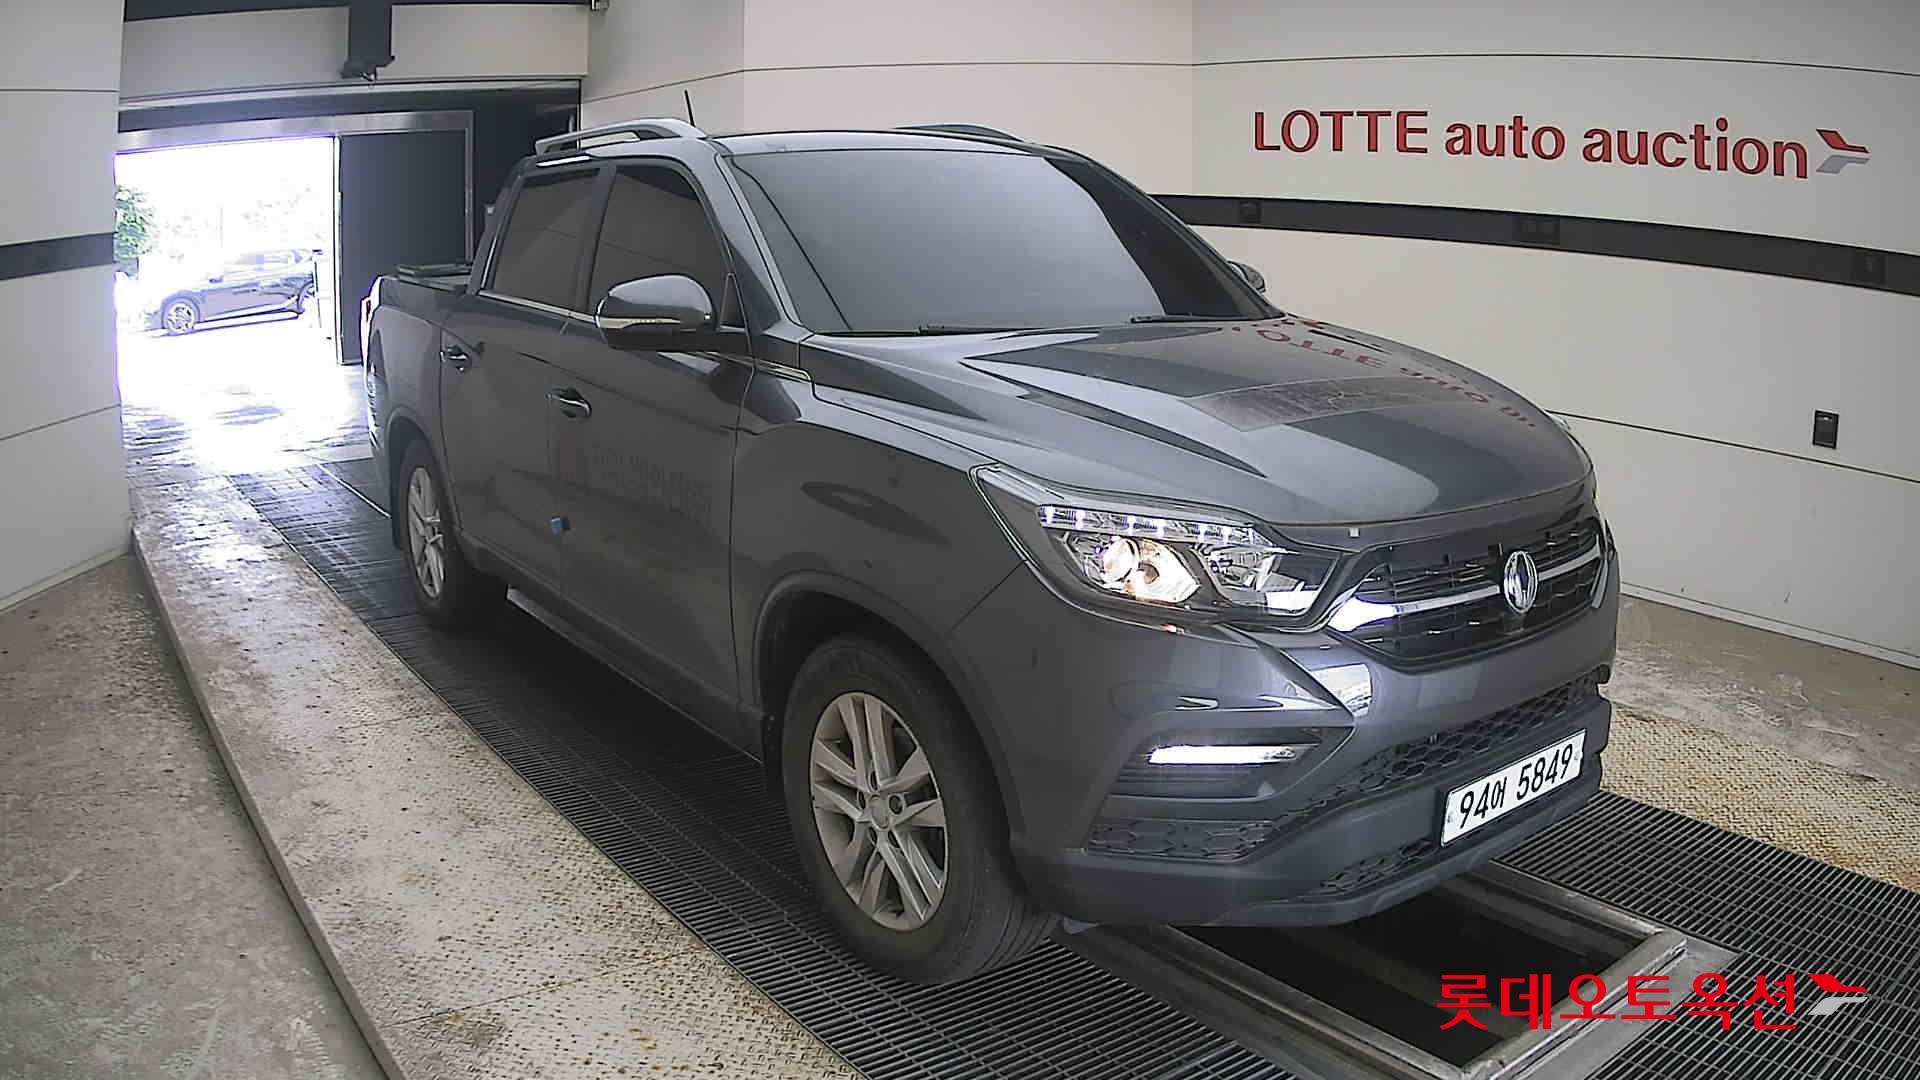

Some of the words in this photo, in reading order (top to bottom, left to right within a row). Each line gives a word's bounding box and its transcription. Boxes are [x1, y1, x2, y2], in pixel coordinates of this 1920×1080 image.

[1253, 110, 1427, 154] LOTTE
[1445, 115, 1566, 160] auto
[1582, 117, 1808, 179] auction
[1459, 776, 1508, 830] 94어
[1515, 743, 1573, 801] 5849
